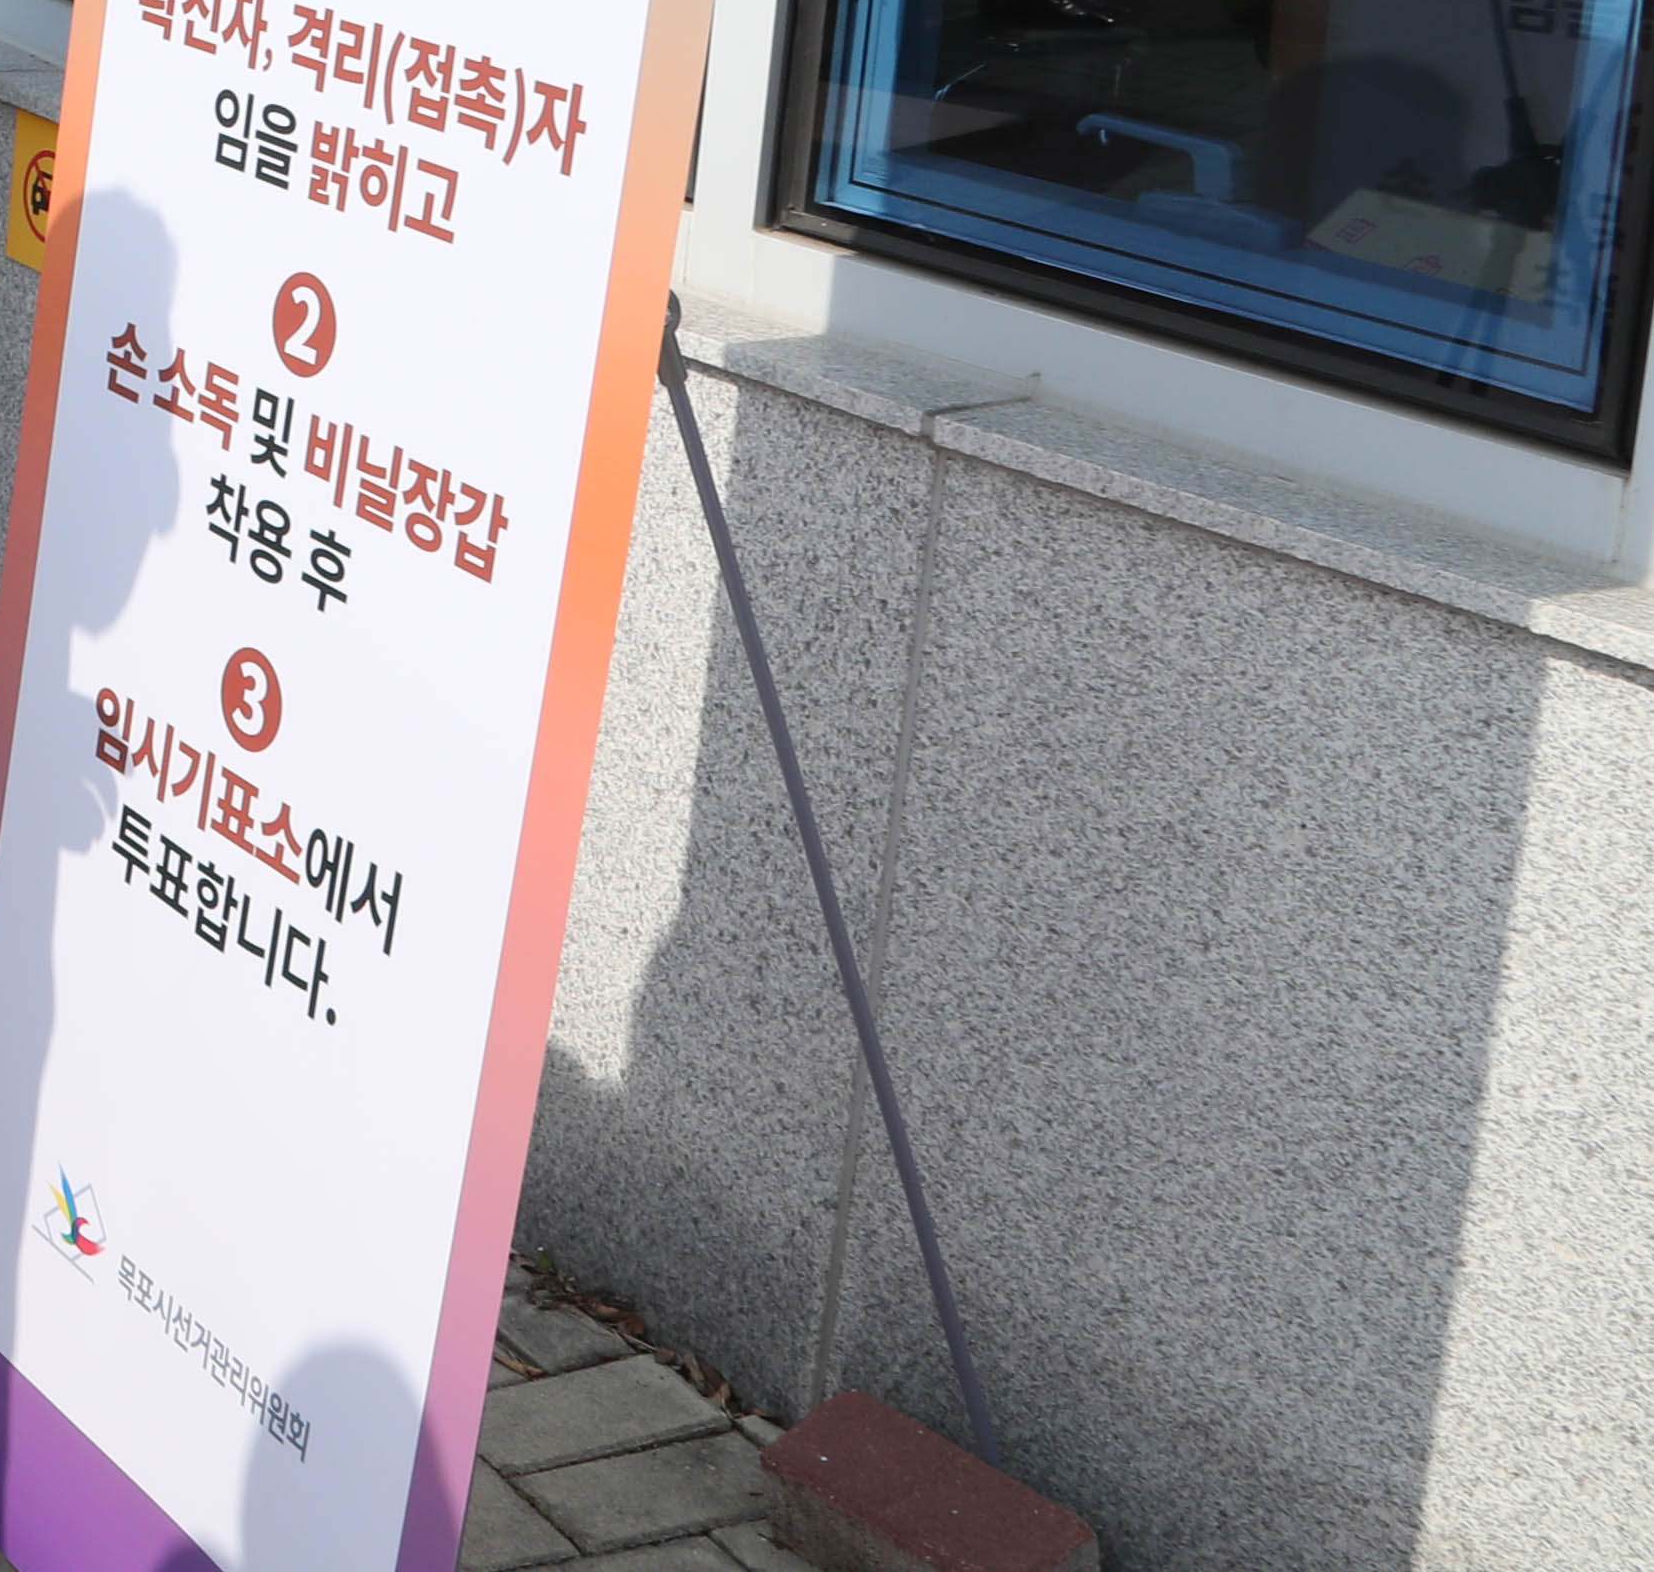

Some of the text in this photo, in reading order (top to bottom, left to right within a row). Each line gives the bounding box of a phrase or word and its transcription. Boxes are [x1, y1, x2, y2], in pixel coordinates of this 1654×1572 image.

[214, 88, 460, 245] 임을 밝히고
[287, 3, 588, 177] 격리(접촉)자
[105, 321, 509, 584] 손 소독 및 비닐장갑
[205, 472, 352, 613] 착용 후
[95, 686, 404, 957] 임시기표소에서
[111, 803, 337, 1026] 투표합니다.
[117, 1254, 311, 1464] 목포시선거관리위원회
